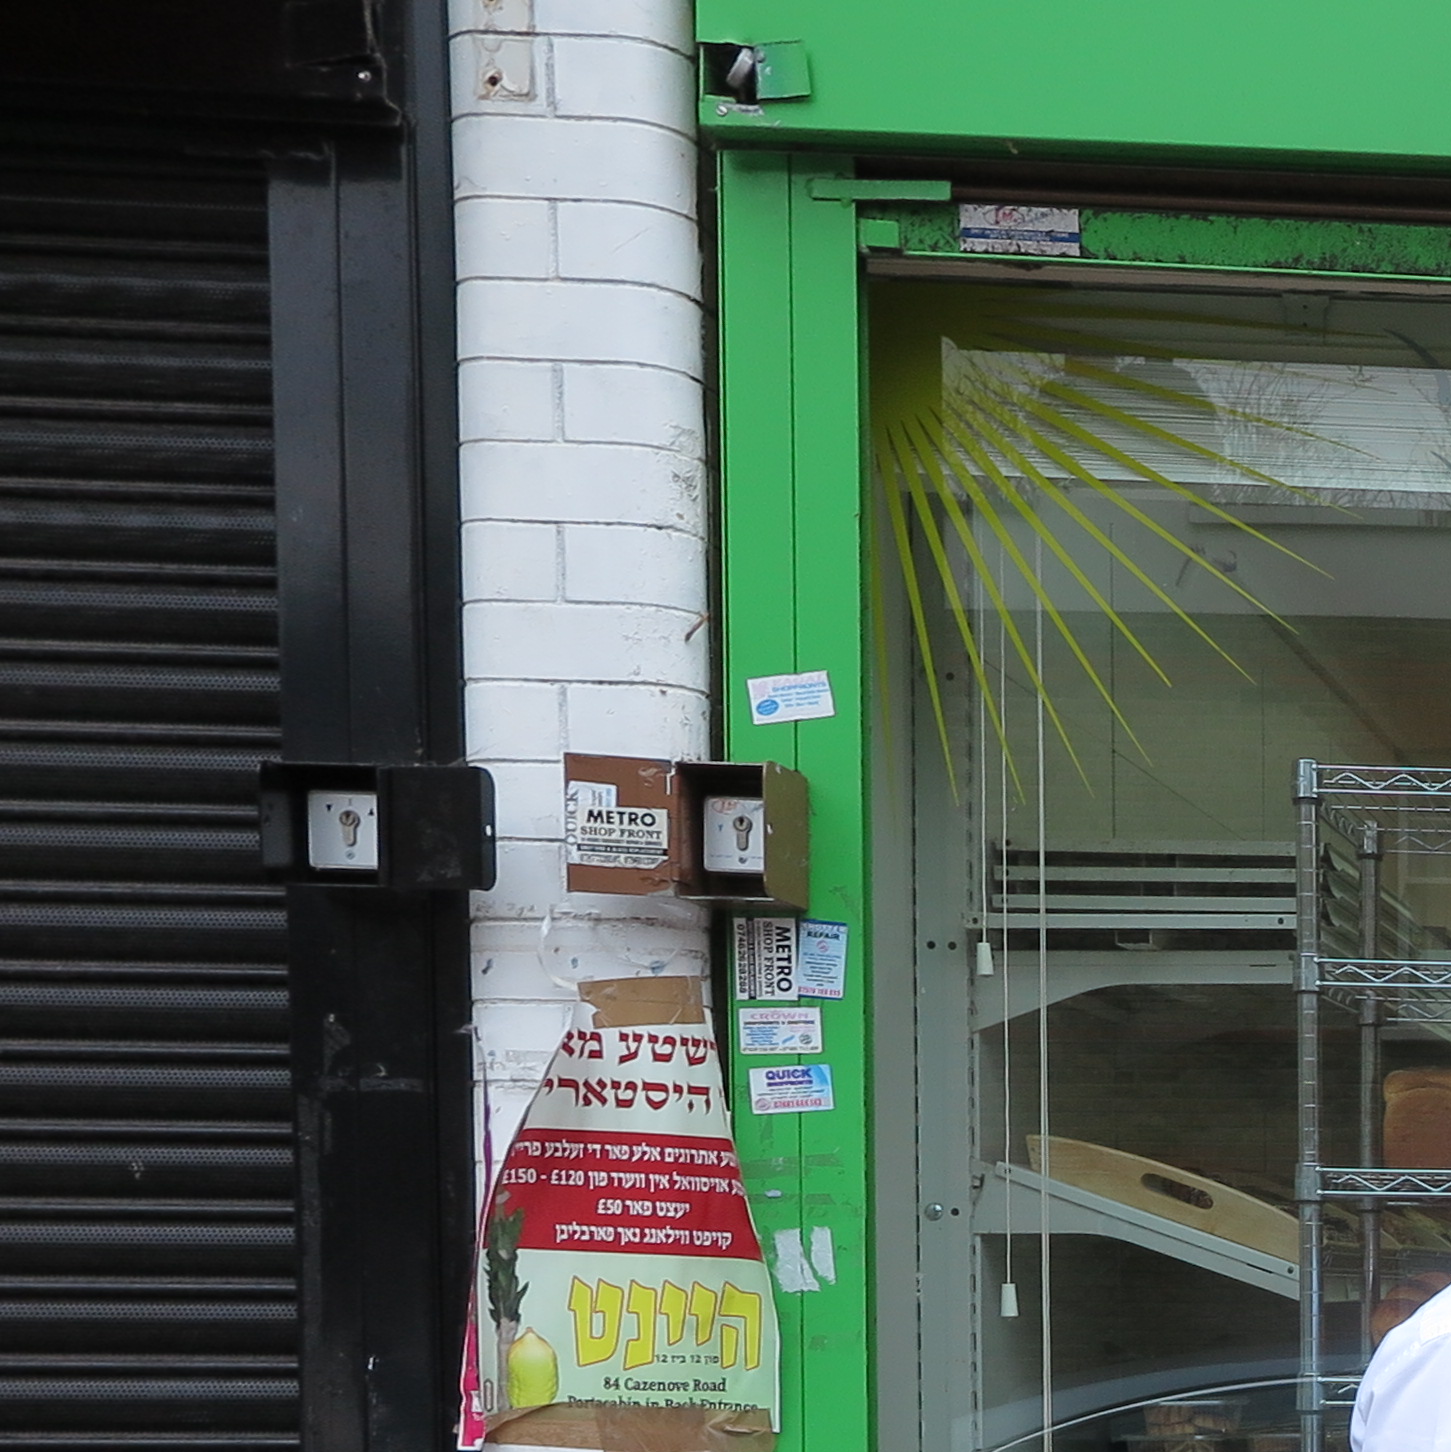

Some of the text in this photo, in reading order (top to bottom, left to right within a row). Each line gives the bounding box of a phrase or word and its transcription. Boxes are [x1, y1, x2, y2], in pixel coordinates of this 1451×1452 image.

[585, 809, 656, 827] METRO
[580, 825, 662, 840] SHOP FRONT
[763, 920, 775, 996] SHOP FRONT
[775, 925, 793, 992] METRO
[765, 1068, 812, 1080] QUICK
[587, 1143, 601, 1159] די
[632, 1142, 661, 1162] אלע
[502, 1168, 537, 1184] £150
[550, 1169, 584, 1185] £120
[649, 1173, 669, 1192] אין
[597, 1199, 622, 1215] £50
[603, 1376, 727, 1392] 84 Cazenove Road
